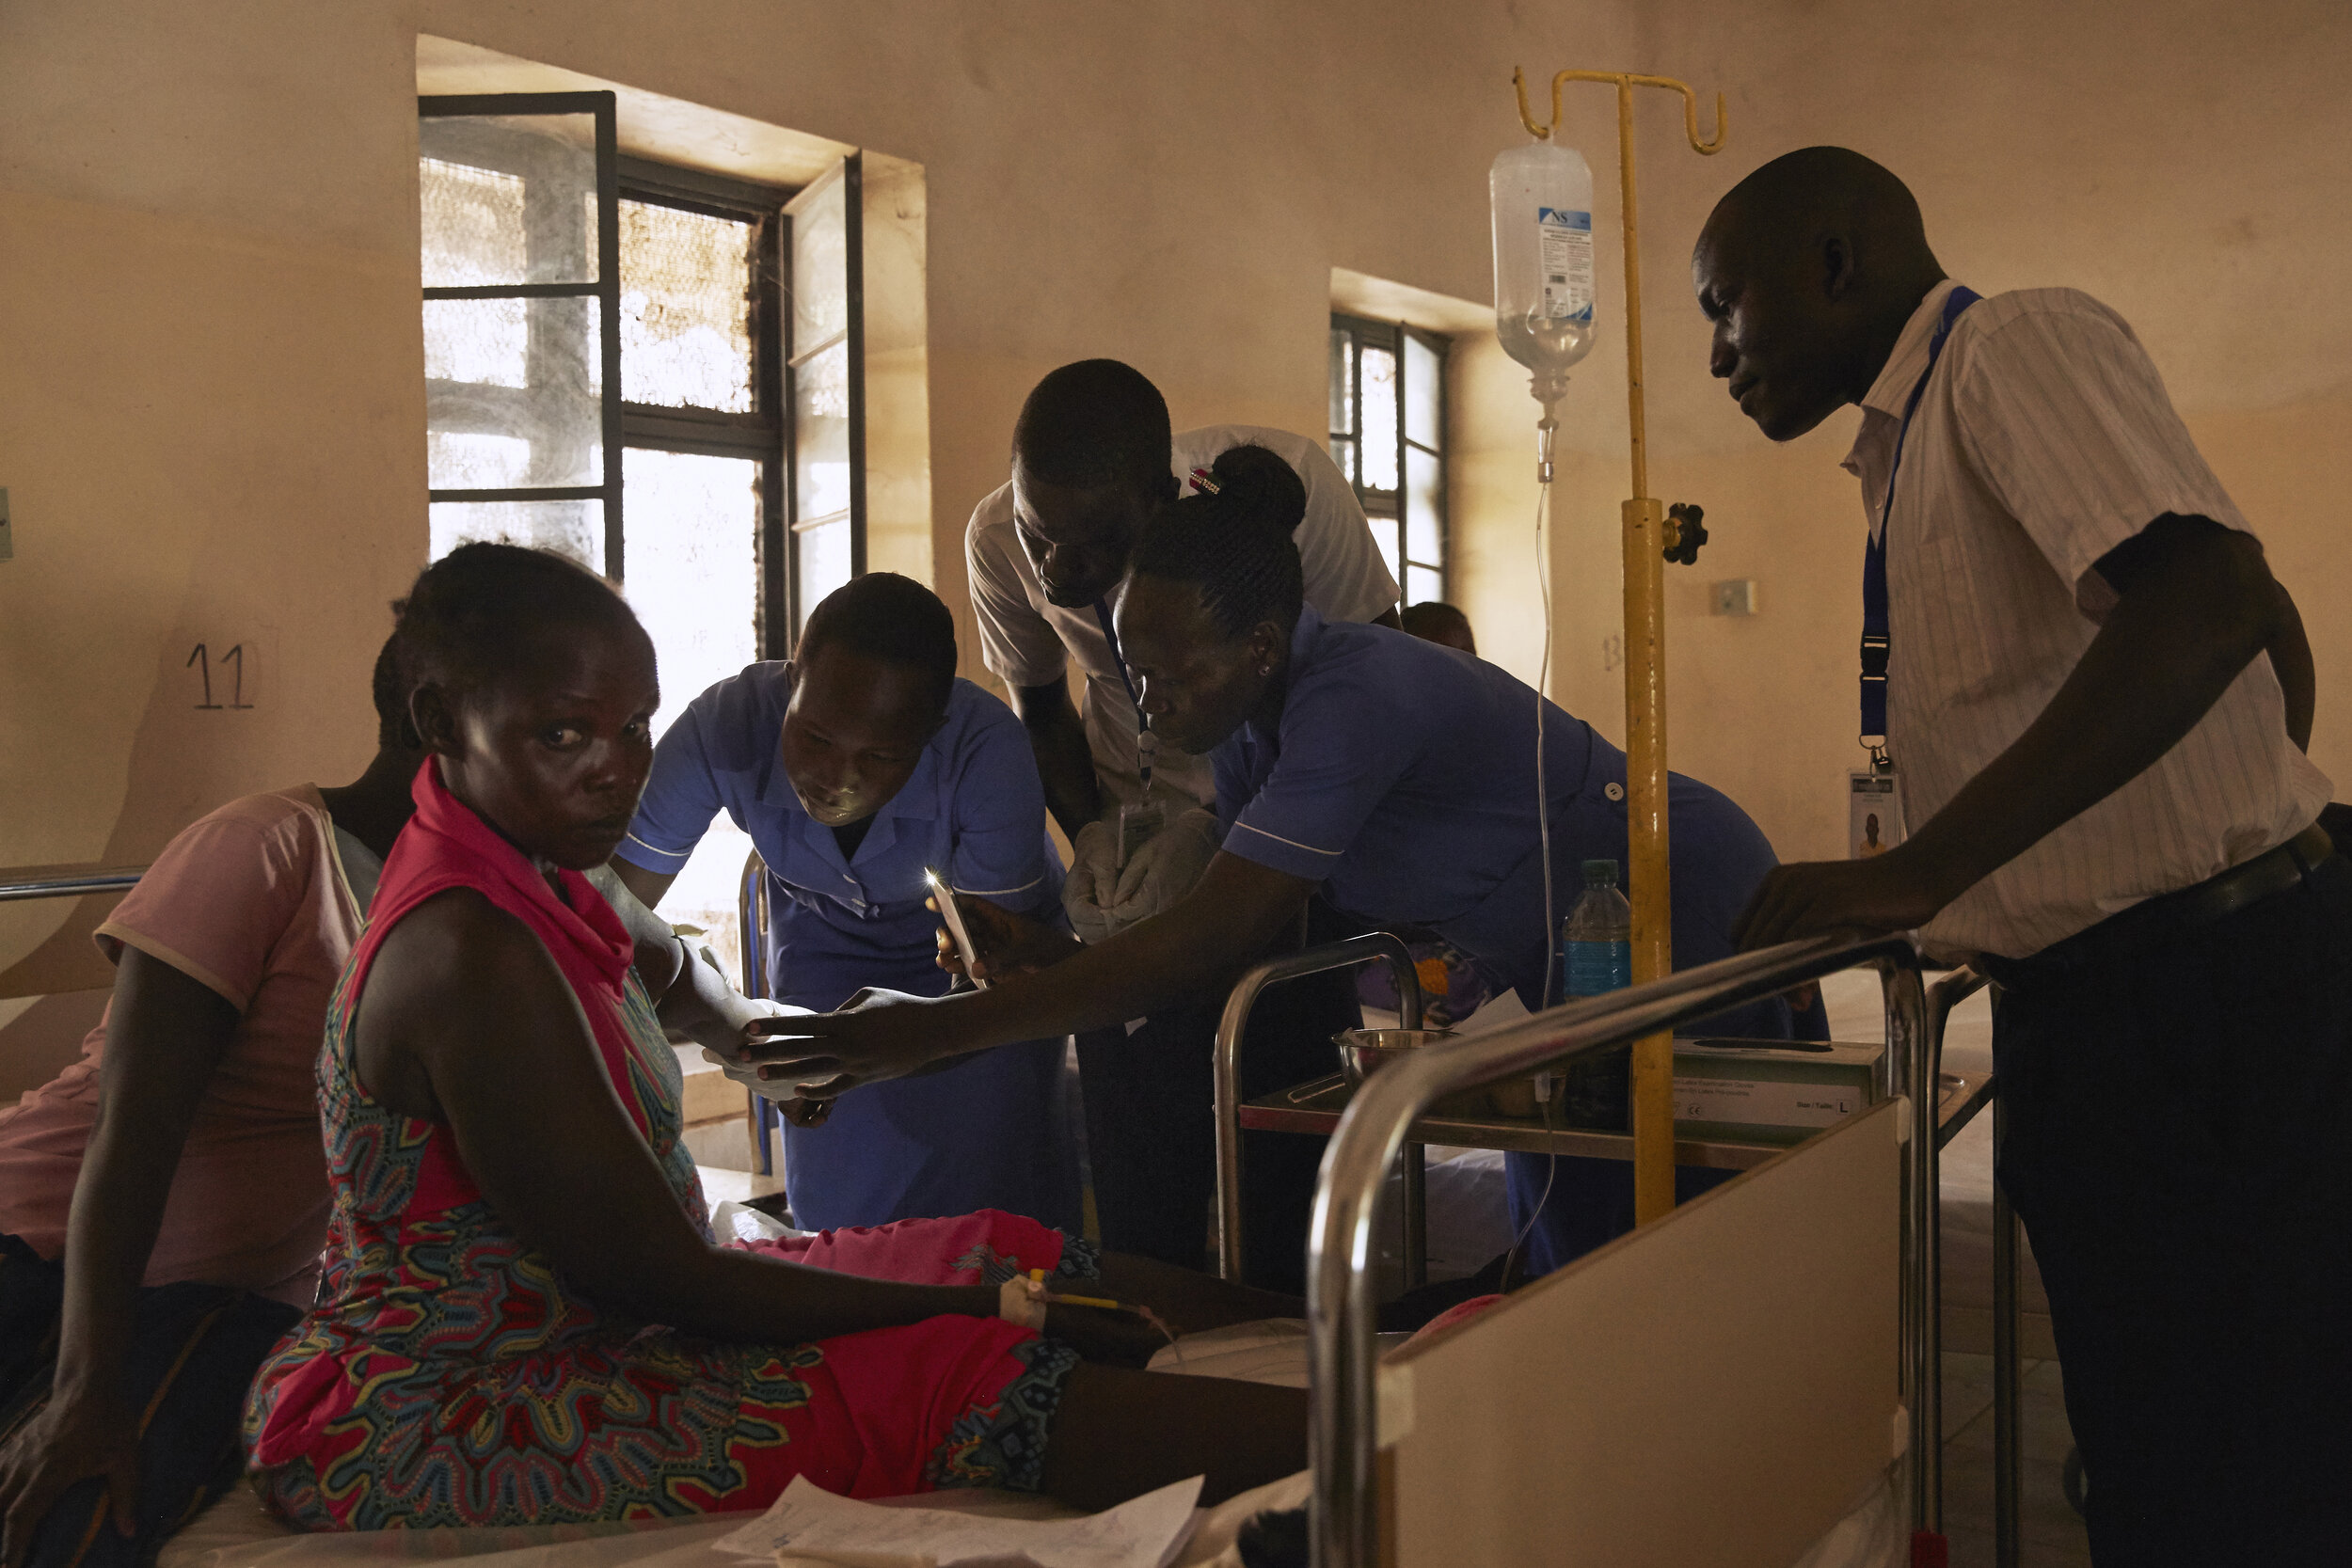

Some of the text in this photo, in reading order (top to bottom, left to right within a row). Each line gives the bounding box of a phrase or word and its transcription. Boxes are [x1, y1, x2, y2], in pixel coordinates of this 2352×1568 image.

[1552, 211, 1567, 224] NS
[186, 642, 254, 710] 11
[1840, 1101, 1849, 1113] L
